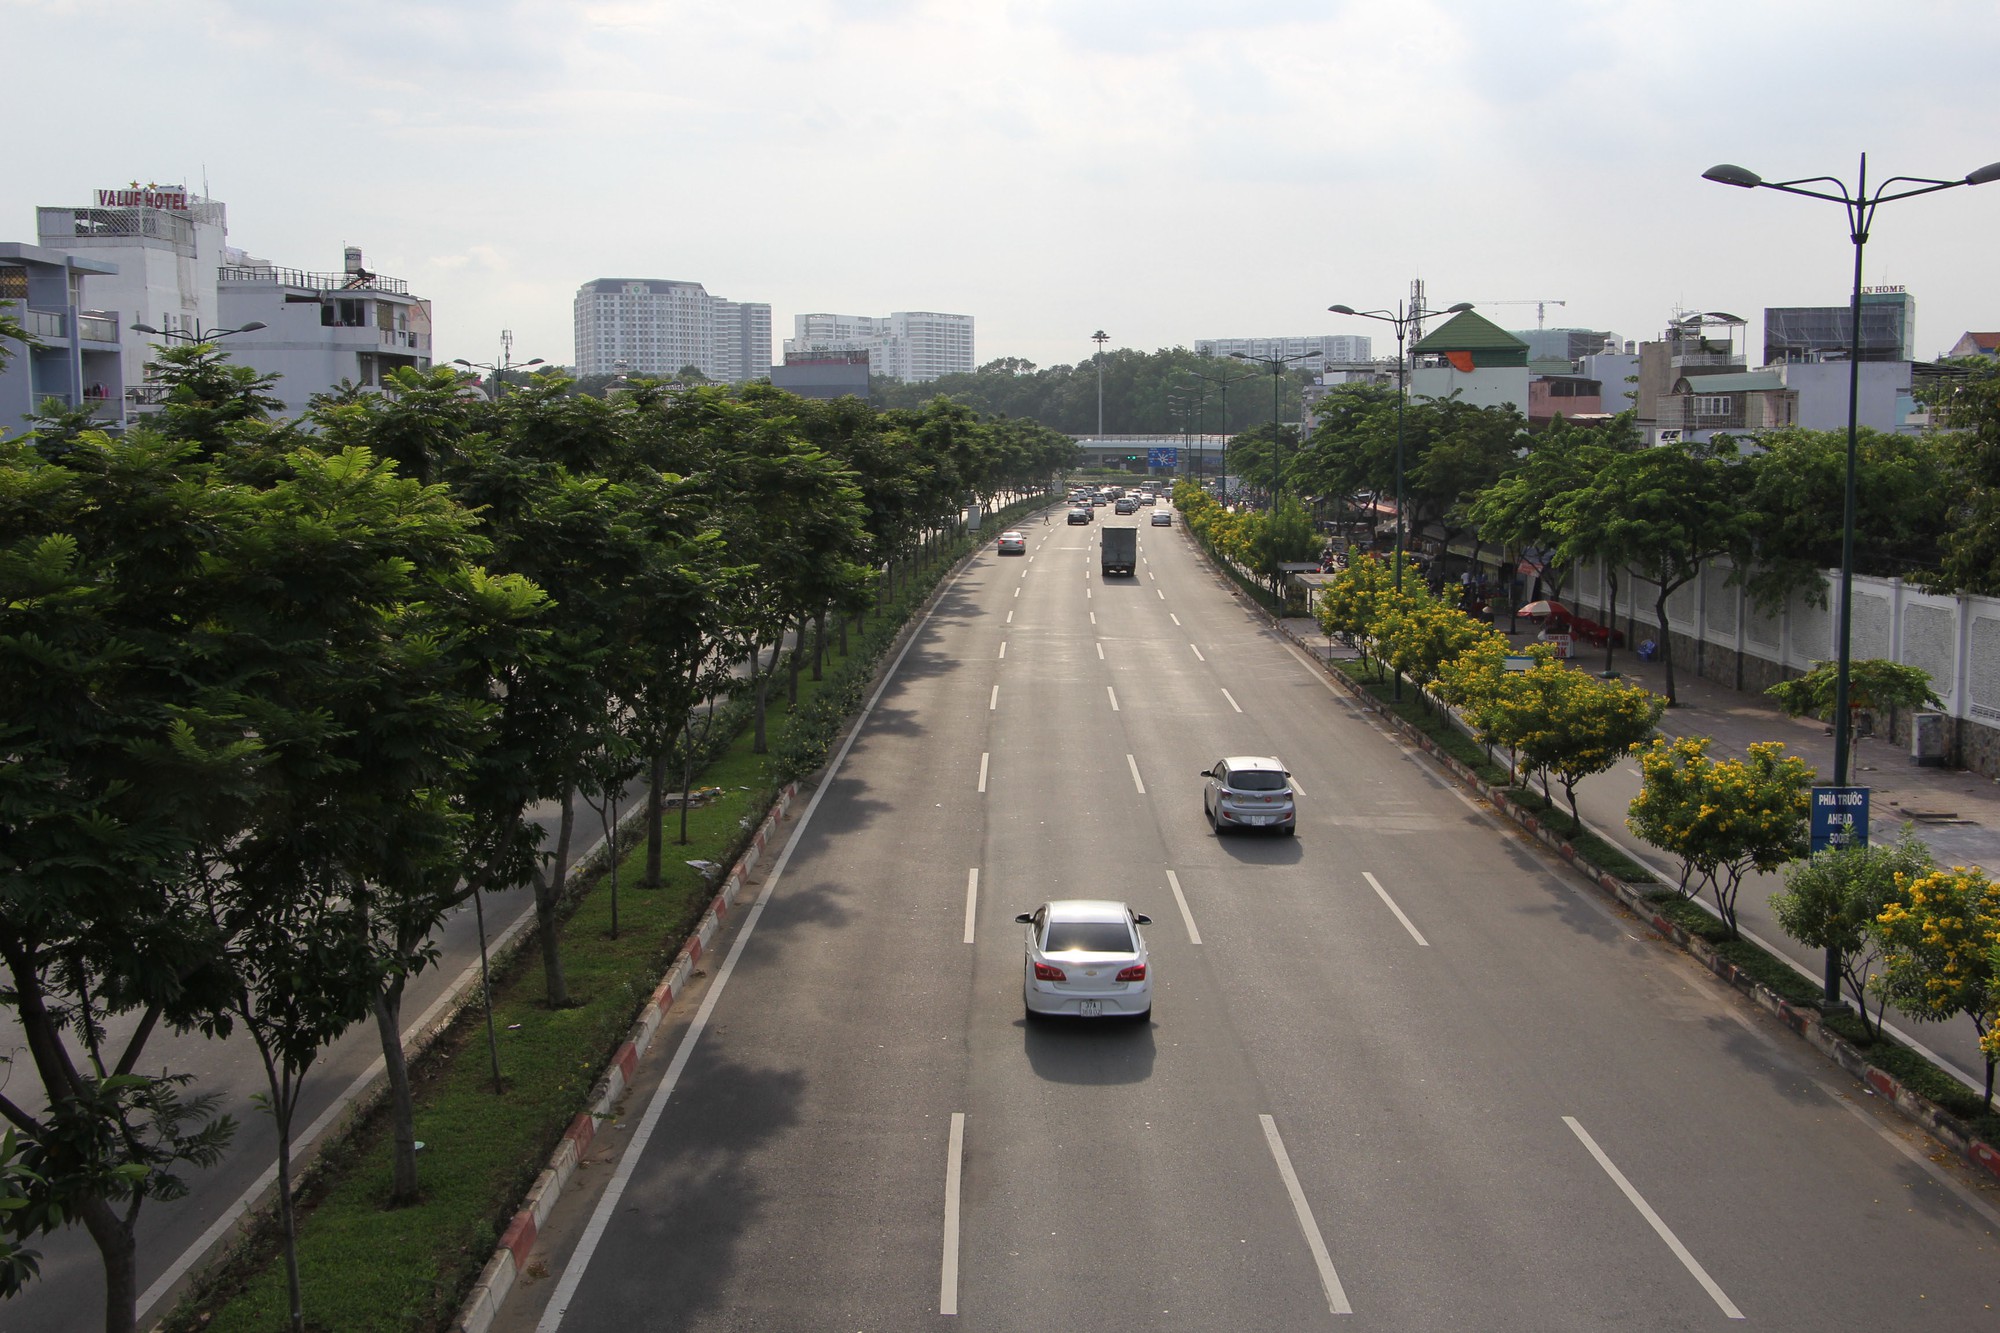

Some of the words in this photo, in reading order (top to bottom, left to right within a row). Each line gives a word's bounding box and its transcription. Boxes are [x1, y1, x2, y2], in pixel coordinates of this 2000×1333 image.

[98, 189, 141, 207] VALUE
[144, 191, 187, 210] HOTEL
[1853, 285, 1873, 294] IN
[1875, 284, 1906, 293] HOME
[1818, 791, 1837, 806] PHÍA
[1837, 790, 1863, 806] TRƯỚC
[1827, 813, 1853, 827] AHEAD
